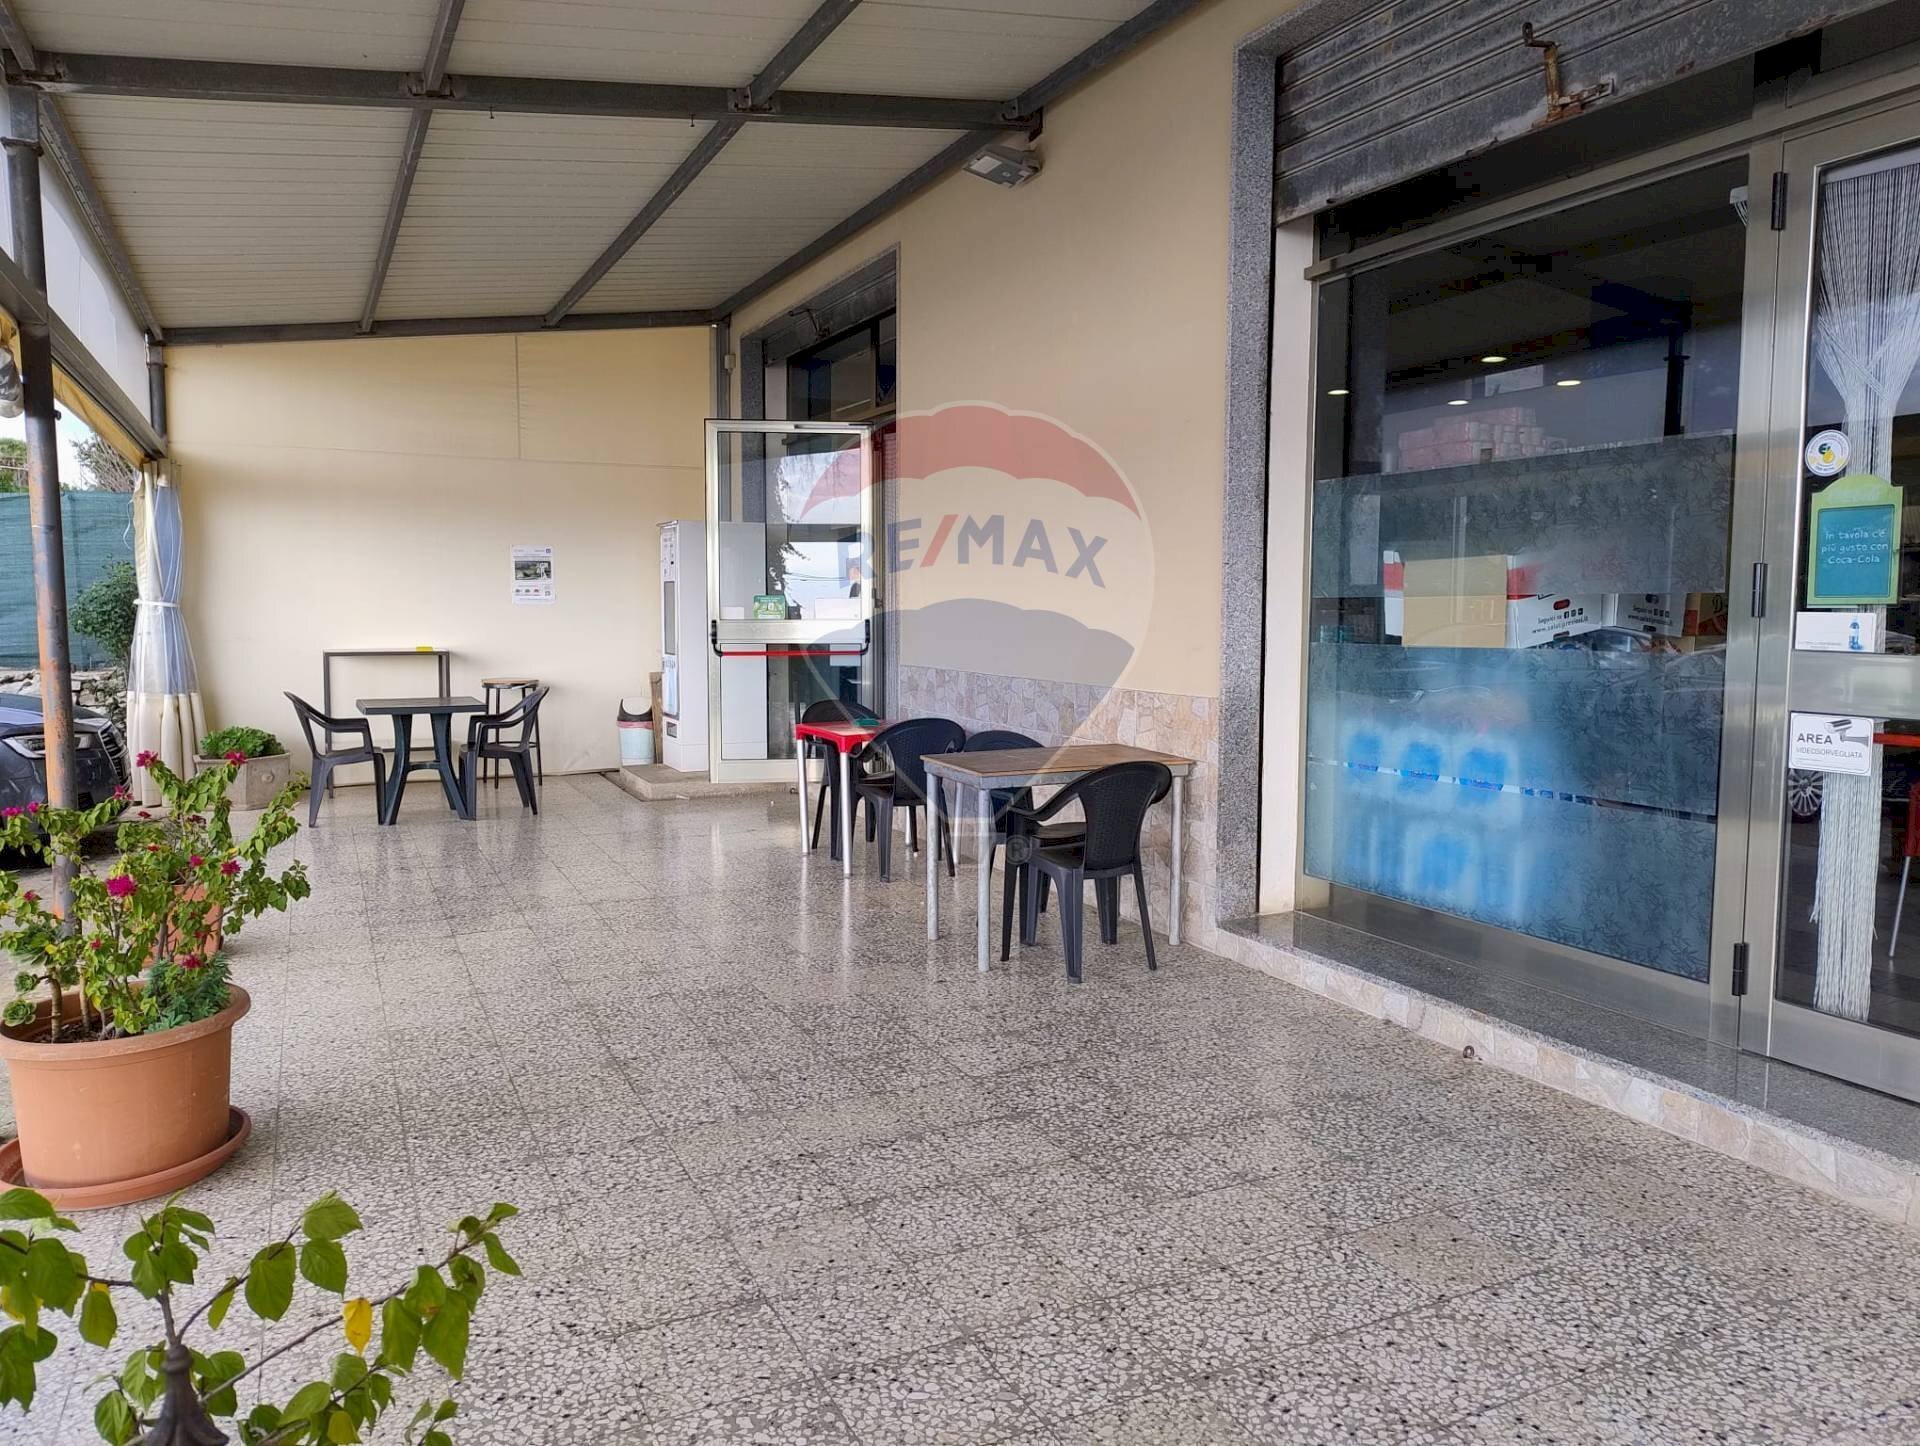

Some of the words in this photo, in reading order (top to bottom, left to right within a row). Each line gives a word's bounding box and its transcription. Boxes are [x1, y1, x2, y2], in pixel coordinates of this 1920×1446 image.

[1838, 530, 1869, 540] tavola
[1839, 543, 1868, 554] gusto
[1870, 543, 1889, 551] con
[1828, 554, 1880, 564] Coca-Cola
[1796, 732, 1833, 745] AREA
[1796, 746, 1863, 759] VIDEOSORVEGLIATA
